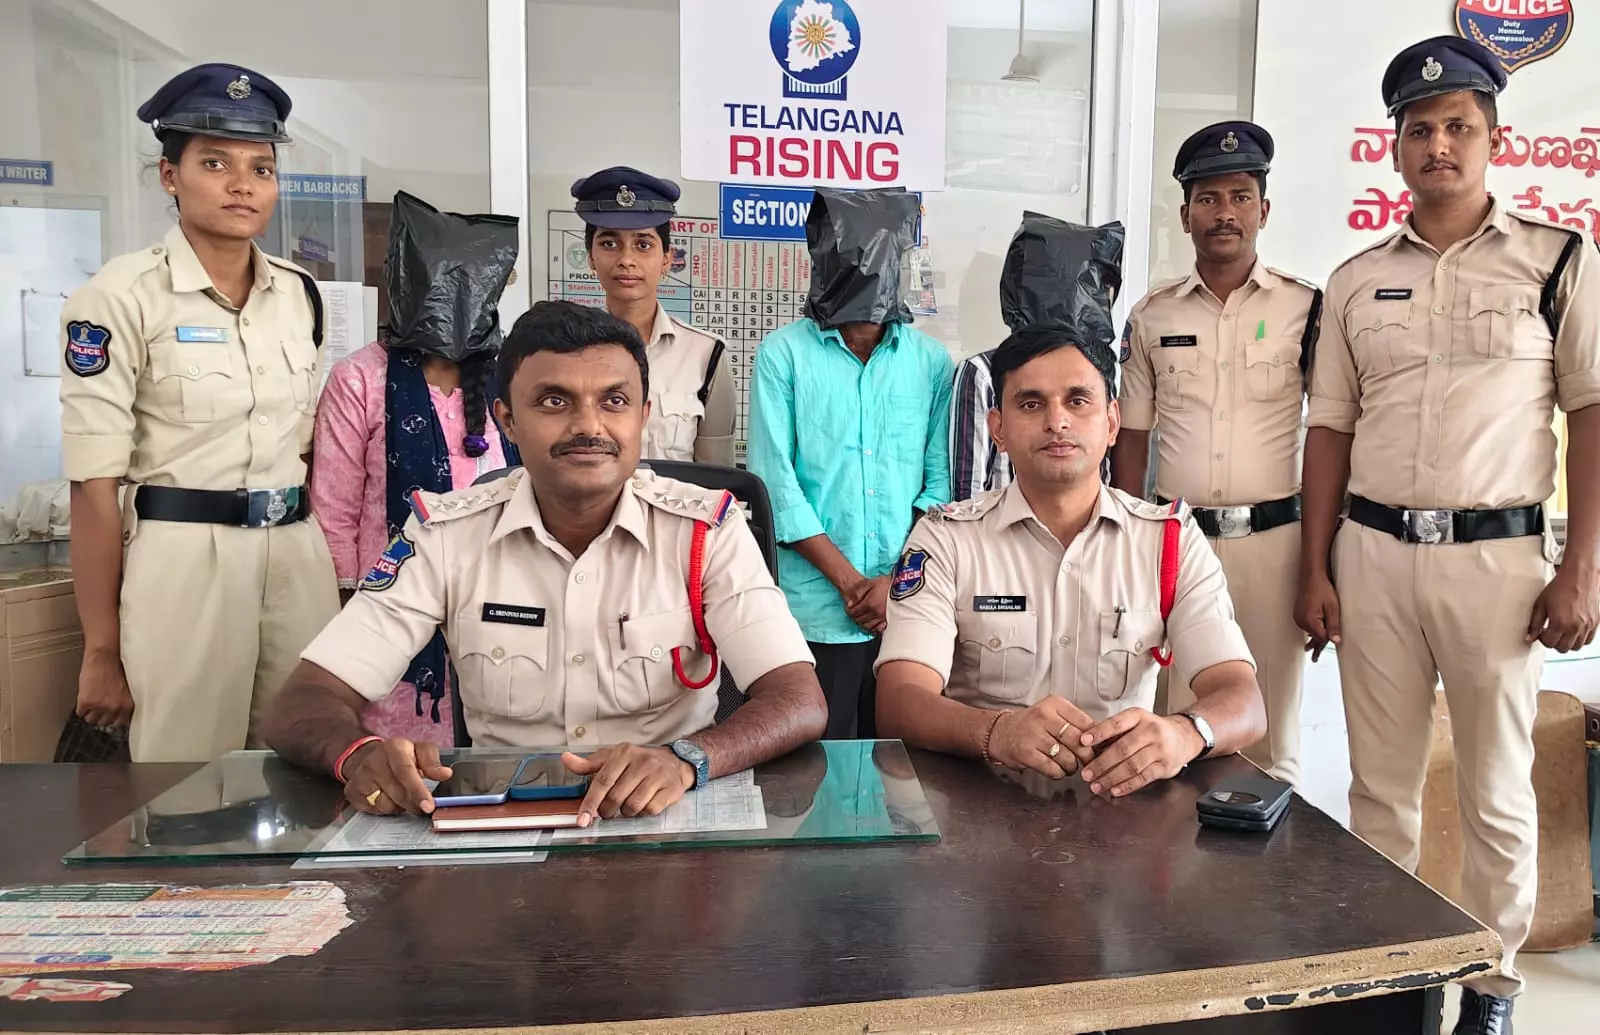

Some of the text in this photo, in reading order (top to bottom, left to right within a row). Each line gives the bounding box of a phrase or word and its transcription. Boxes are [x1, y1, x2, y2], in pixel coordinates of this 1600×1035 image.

[1503, 20, 1521, 29] Duty
[1498, 27, 1525, 35] Honour
[1489, 34, 1535, 42] Compassion
[724, 103, 904, 135] TELANGANA
[730, 135, 899, 182] RISING
[6, 166, 47, 180] WRITER
[304, 181, 359, 194] BARRACKS
[732, 199, 810, 227] SECTION
[700, 223, 718, 233] OF
[569, 273, 600, 281] PROC
[715, 291, 722, 299] R
[732, 291, 740, 300] R
[750, 292, 758, 301] R
[766, 292, 774, 302] S
[782, 293, 790, 302] S
[694, 303, 705, 311] CA
[714, 303, 722, 312] R
[732, 303, 740, 312] S
[750, 304, 757, 313] S
[766, 305, 774, 314] S
[695, 315, 774, 327] CI AR S S S
[731, 329, 739, 339] R
[750, 330, 757, 339] R
[70, 343, 102, 357] POLICE
[731, 354, 739, 363] S
